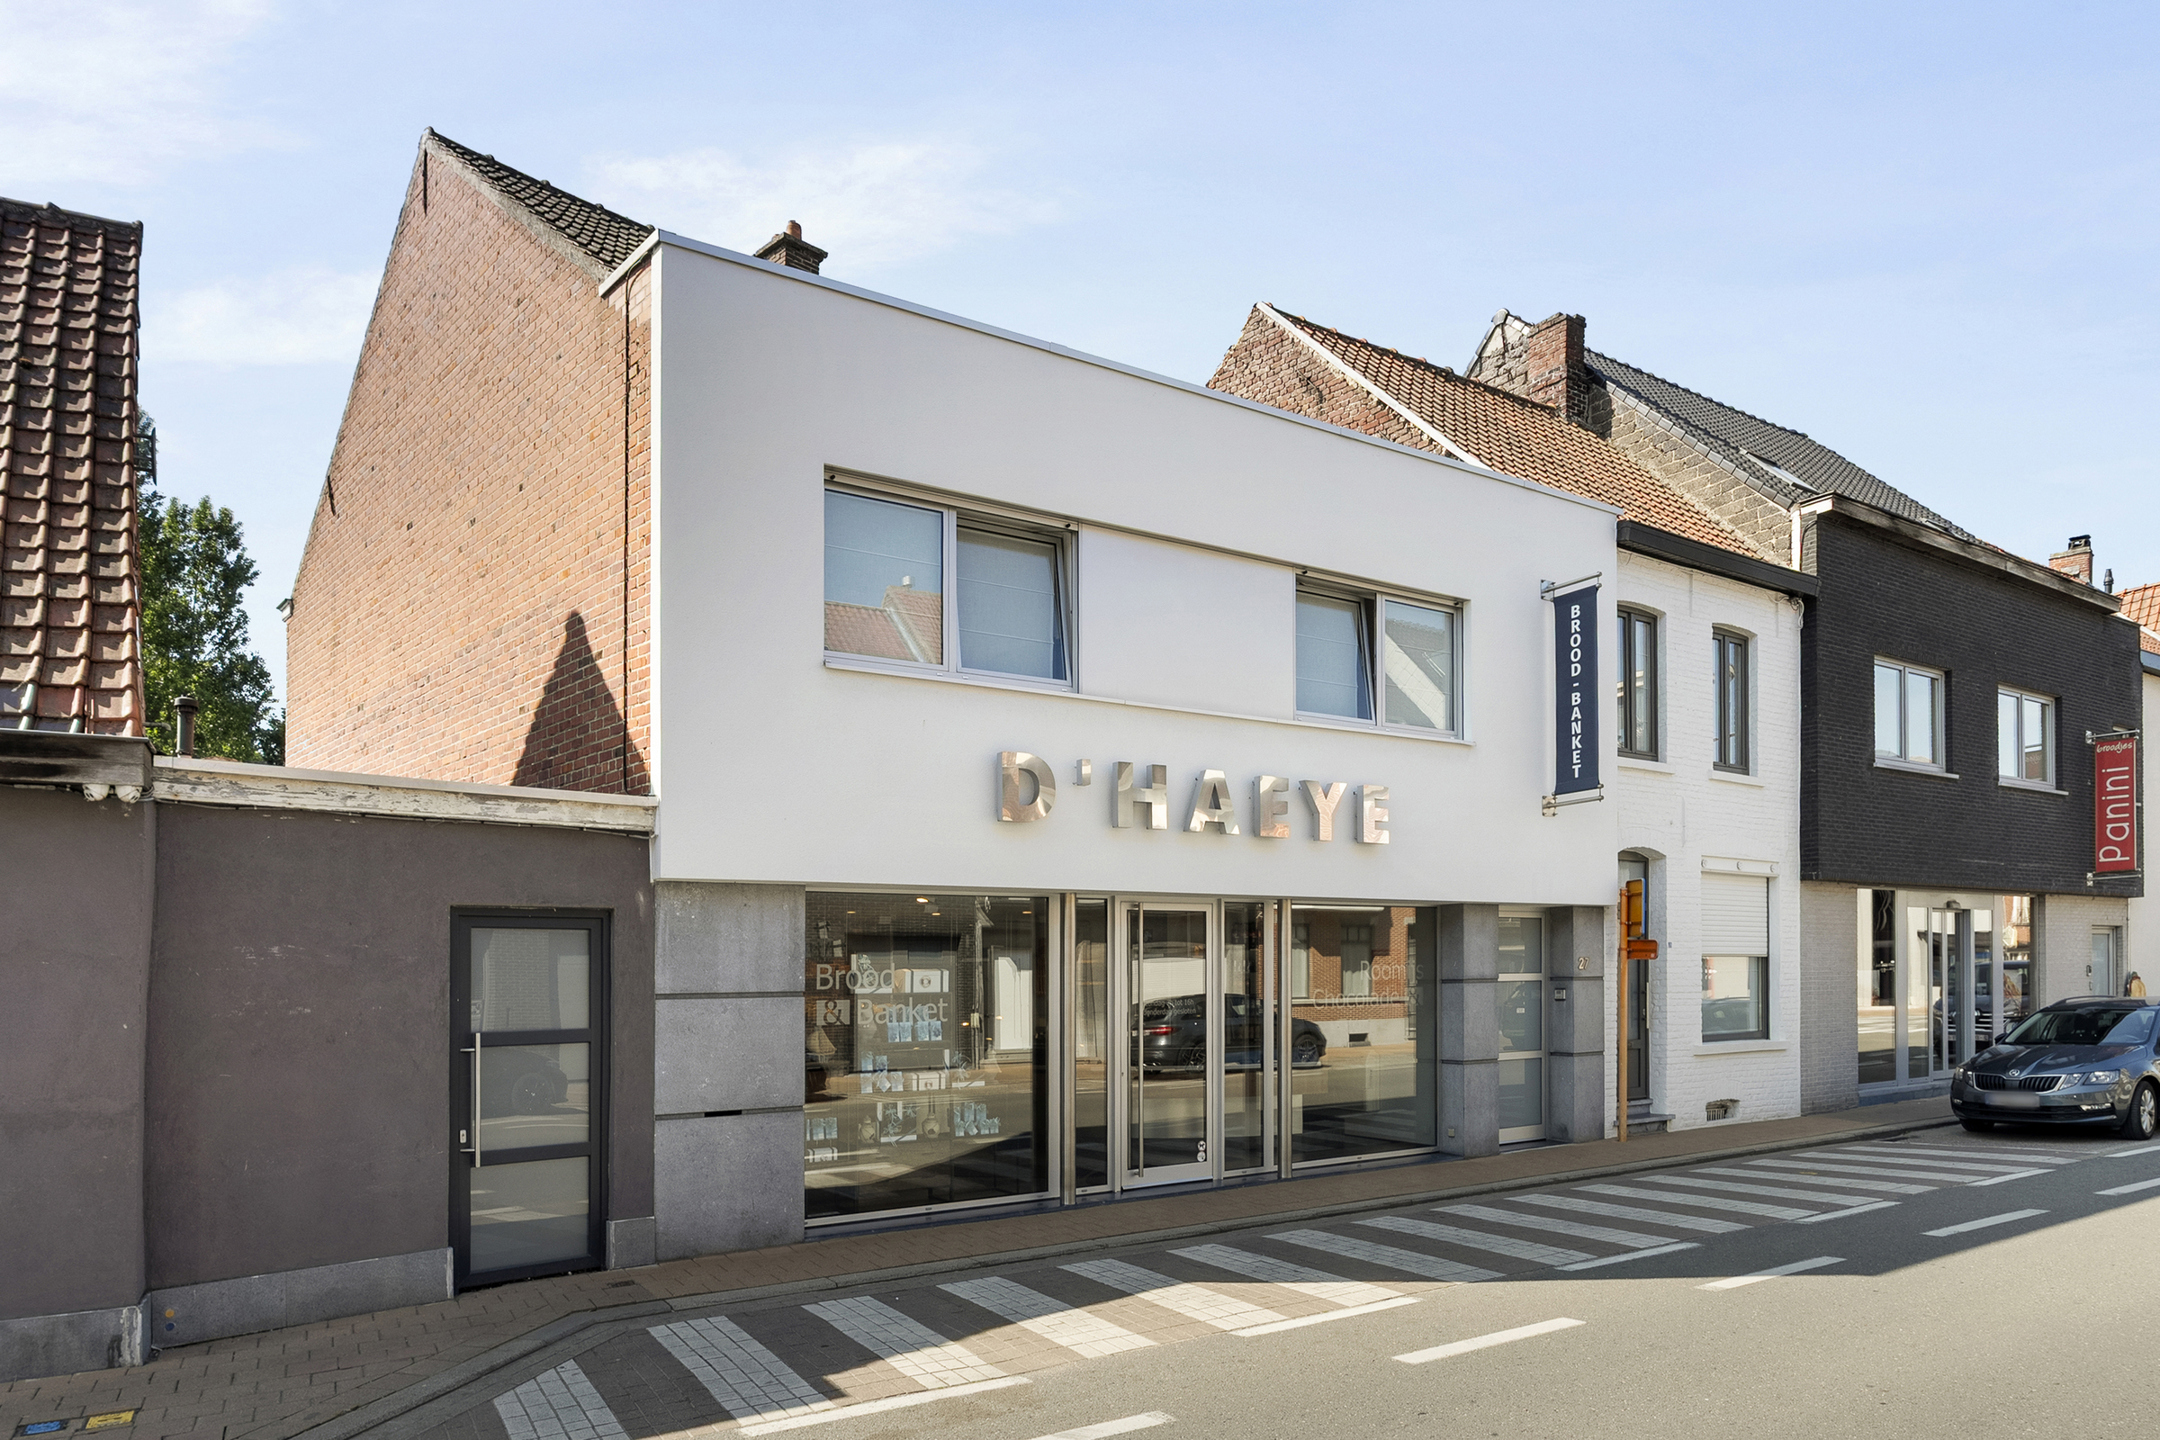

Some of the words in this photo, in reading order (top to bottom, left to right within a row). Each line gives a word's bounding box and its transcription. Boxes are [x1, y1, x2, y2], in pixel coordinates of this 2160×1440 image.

[996, 750, 1391, 845] D'HAEYE
[2098, 766, 2130, 862] panini
[816, 962, 895, 990] Brood
[1360, 960, 1424, 982] Rooms
[1578, 957, 1590, 970] 27
[823, 999, 847, 1026] &
[857, 997, 949, 1025] Banket
